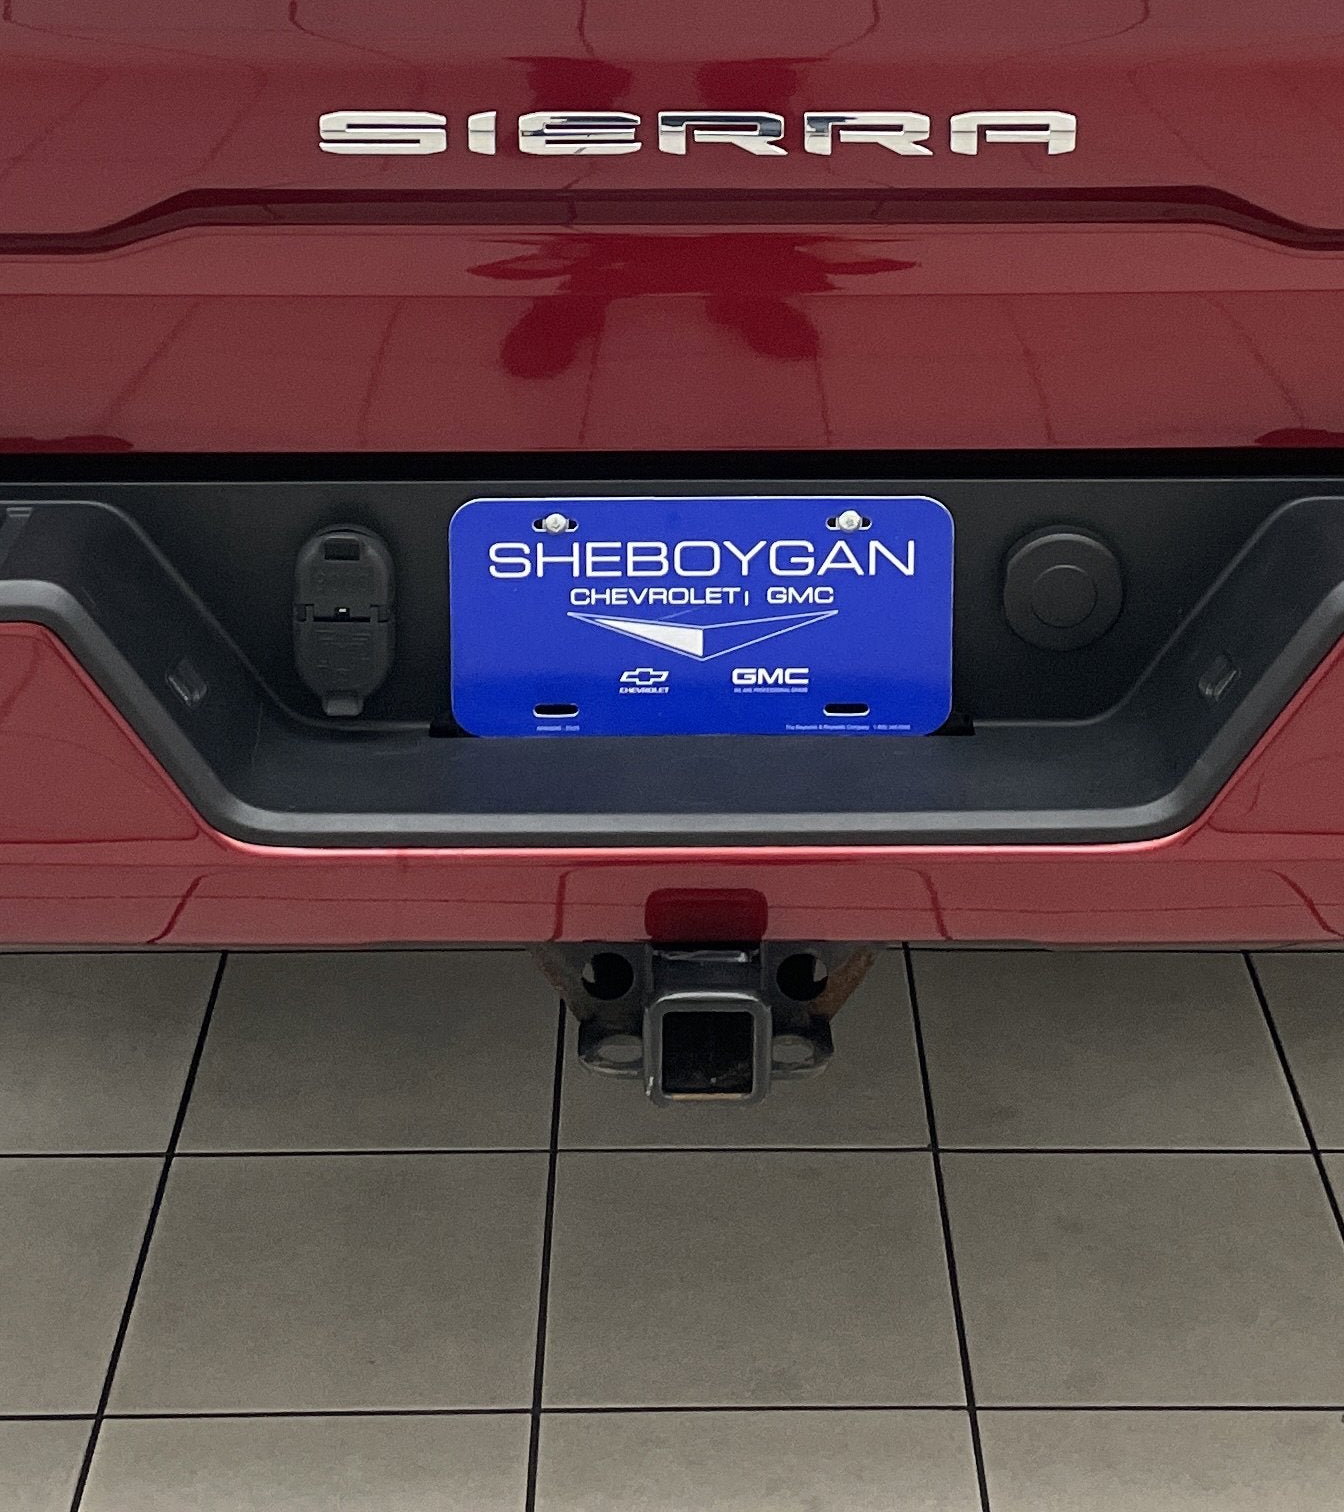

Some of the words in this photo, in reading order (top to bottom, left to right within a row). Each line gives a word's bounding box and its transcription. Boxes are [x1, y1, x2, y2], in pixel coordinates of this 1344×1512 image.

[318, 110, 1077, 156] SIERRA
[488, 539, 916, 579] SHEBOYGAN
[569, 587, 741, 606] CHEVROLET
[766, 586, 835, 605] GMC
[731, 667, 810, 685] GMC
